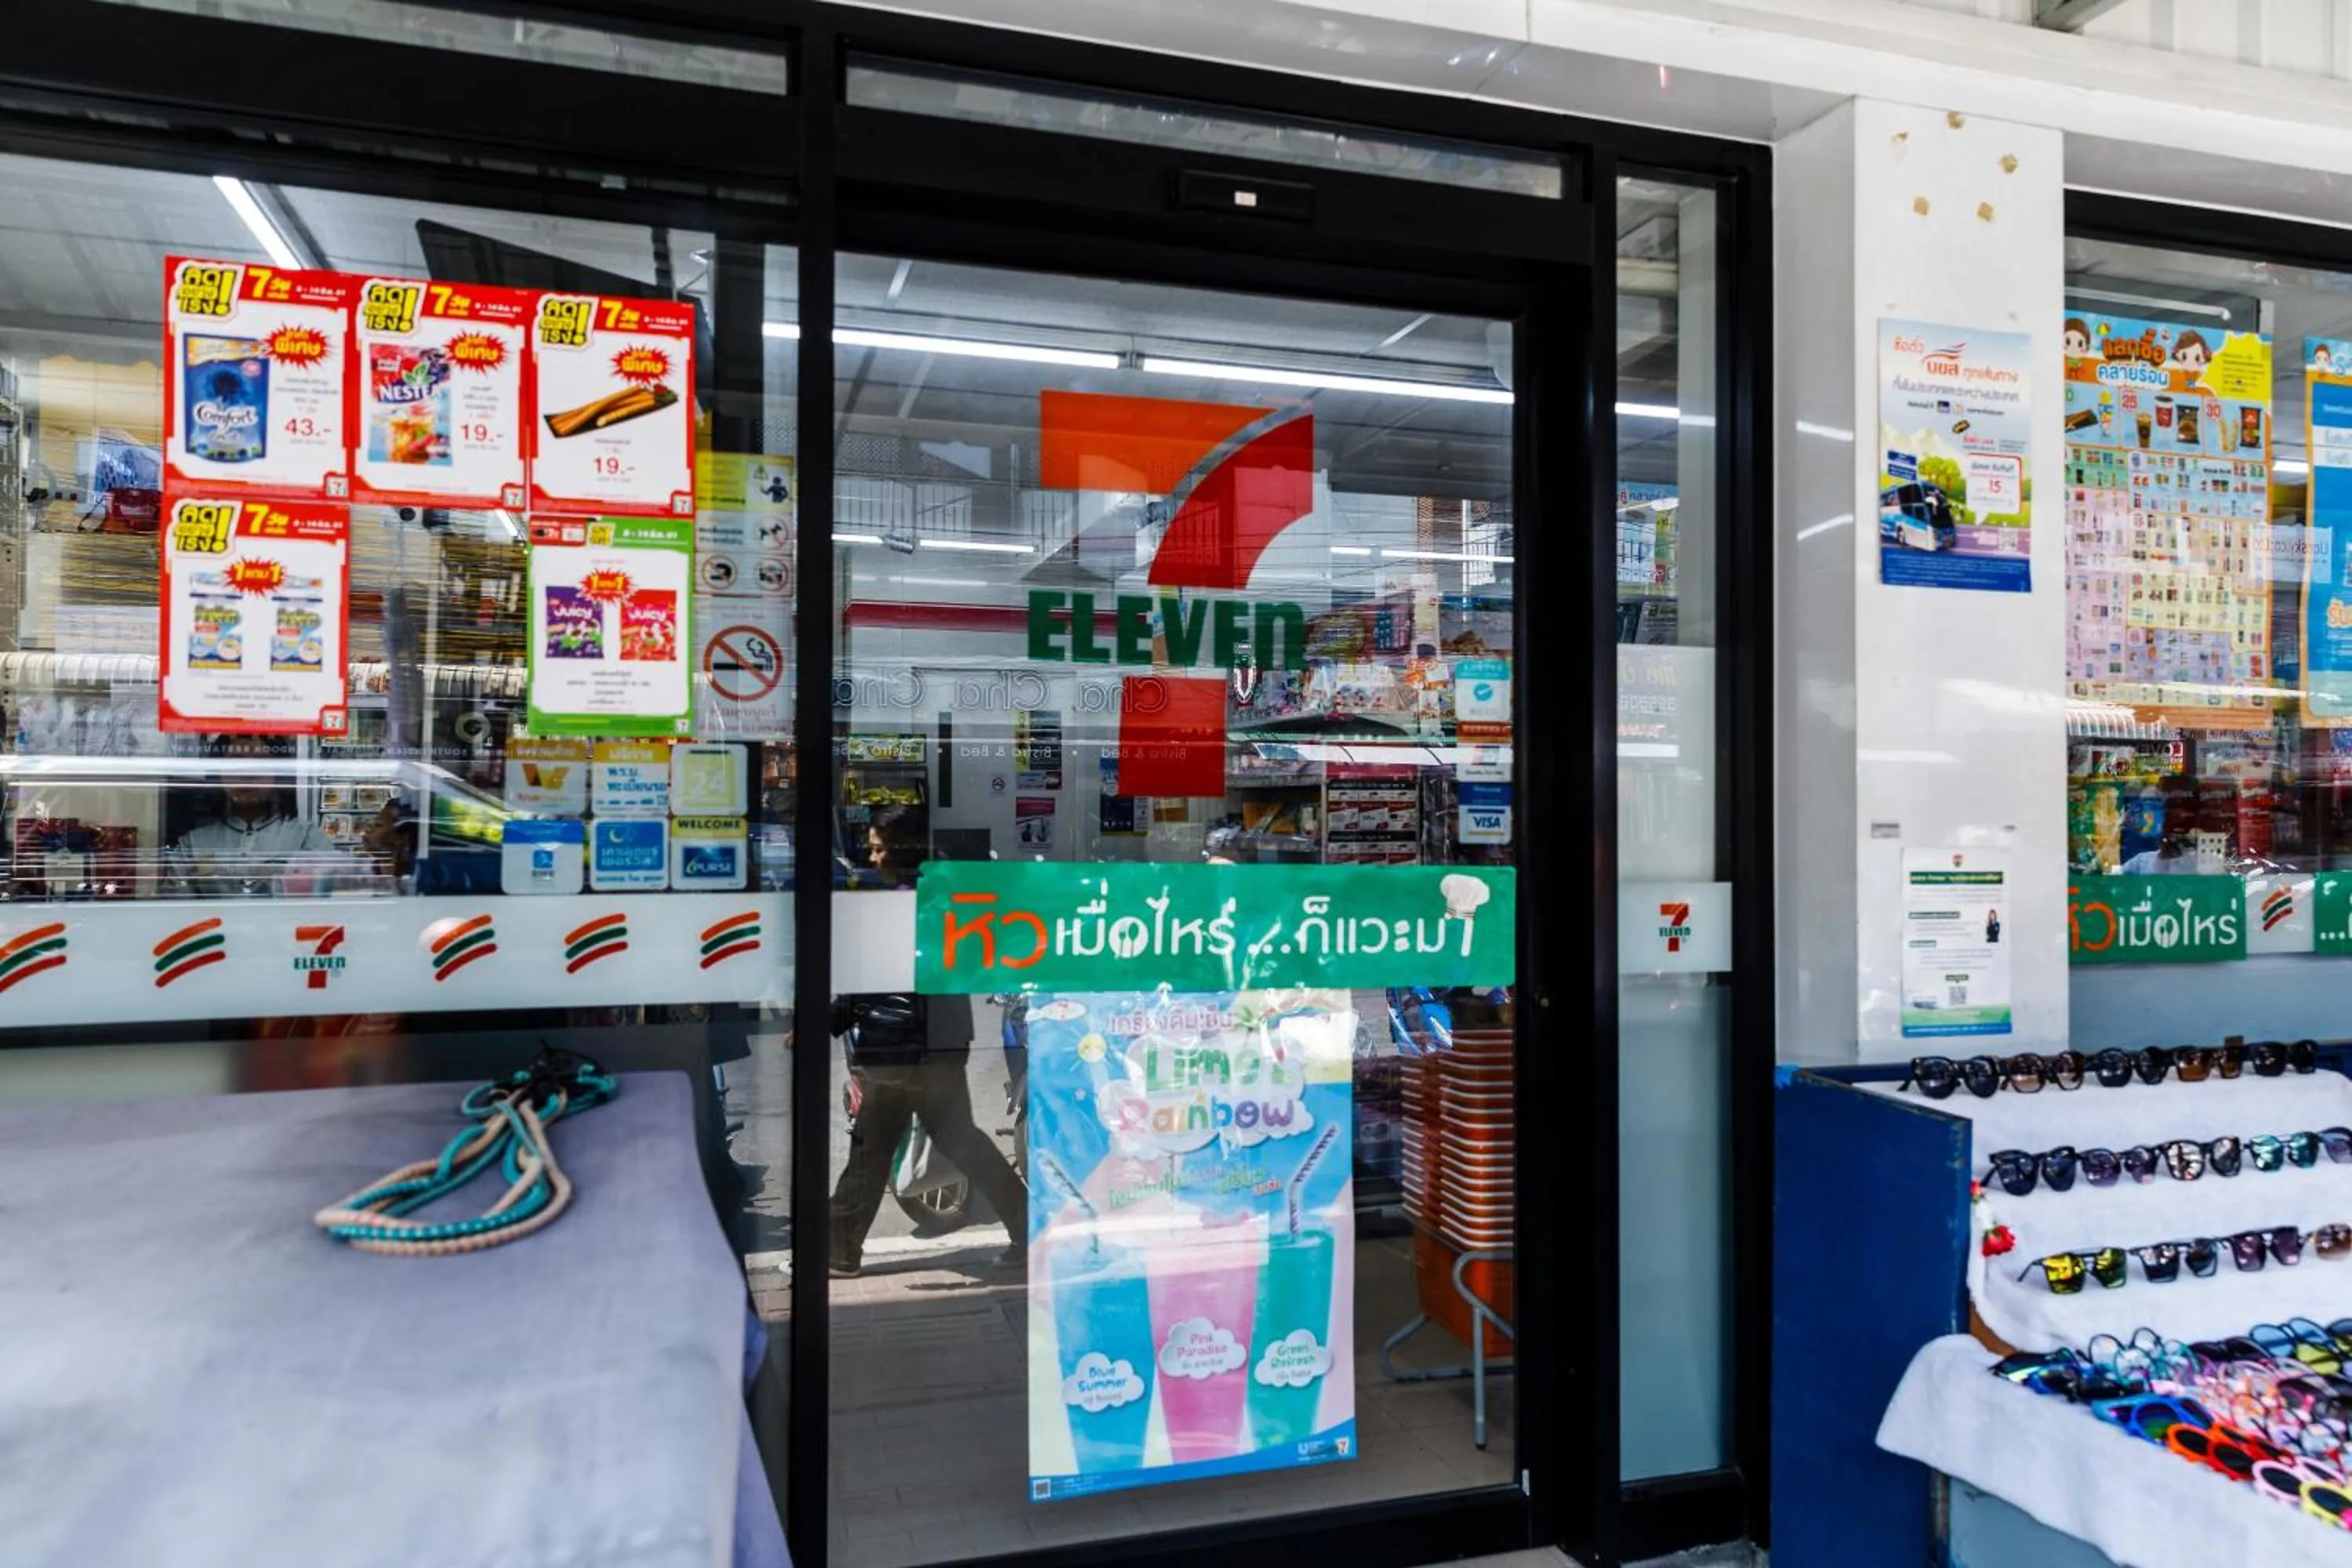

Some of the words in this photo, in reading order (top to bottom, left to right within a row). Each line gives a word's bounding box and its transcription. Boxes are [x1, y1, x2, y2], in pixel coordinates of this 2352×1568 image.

[249, 269, 271, 297] 7
[430, 286, 452, 314] 7
[602, 301, 622, 328] 7
[2097, 361, 2169, 387] คลายร้อน
[2122, 394, 2138, 409] 25
[2206, 401, 2221, 417] 30
[198, 405, 253, 430] Comfort
[246, 505, 269, 533] 7
[1040, 390, 1313, 797] 7
[677, 819, 741, 830] WELCOME
[1473, 816, 1501, 829] VISA
[1660, 903, 1689, 952] 7
[295, 925, 345, 989] 7
[1116, 1093, 1294, 1135] Rainbow
[1190, 1333, 1214, 1345] Pink
[1177, 1345, 1229, 1360] Paradise
[1277, 1344, 1309, 1356] Green
[1088, 1366, 1116, 1378] Blue
[1270, 1355, 1316, 1369] Refresh
[1078, 1377, 1127, 1392] Summer
